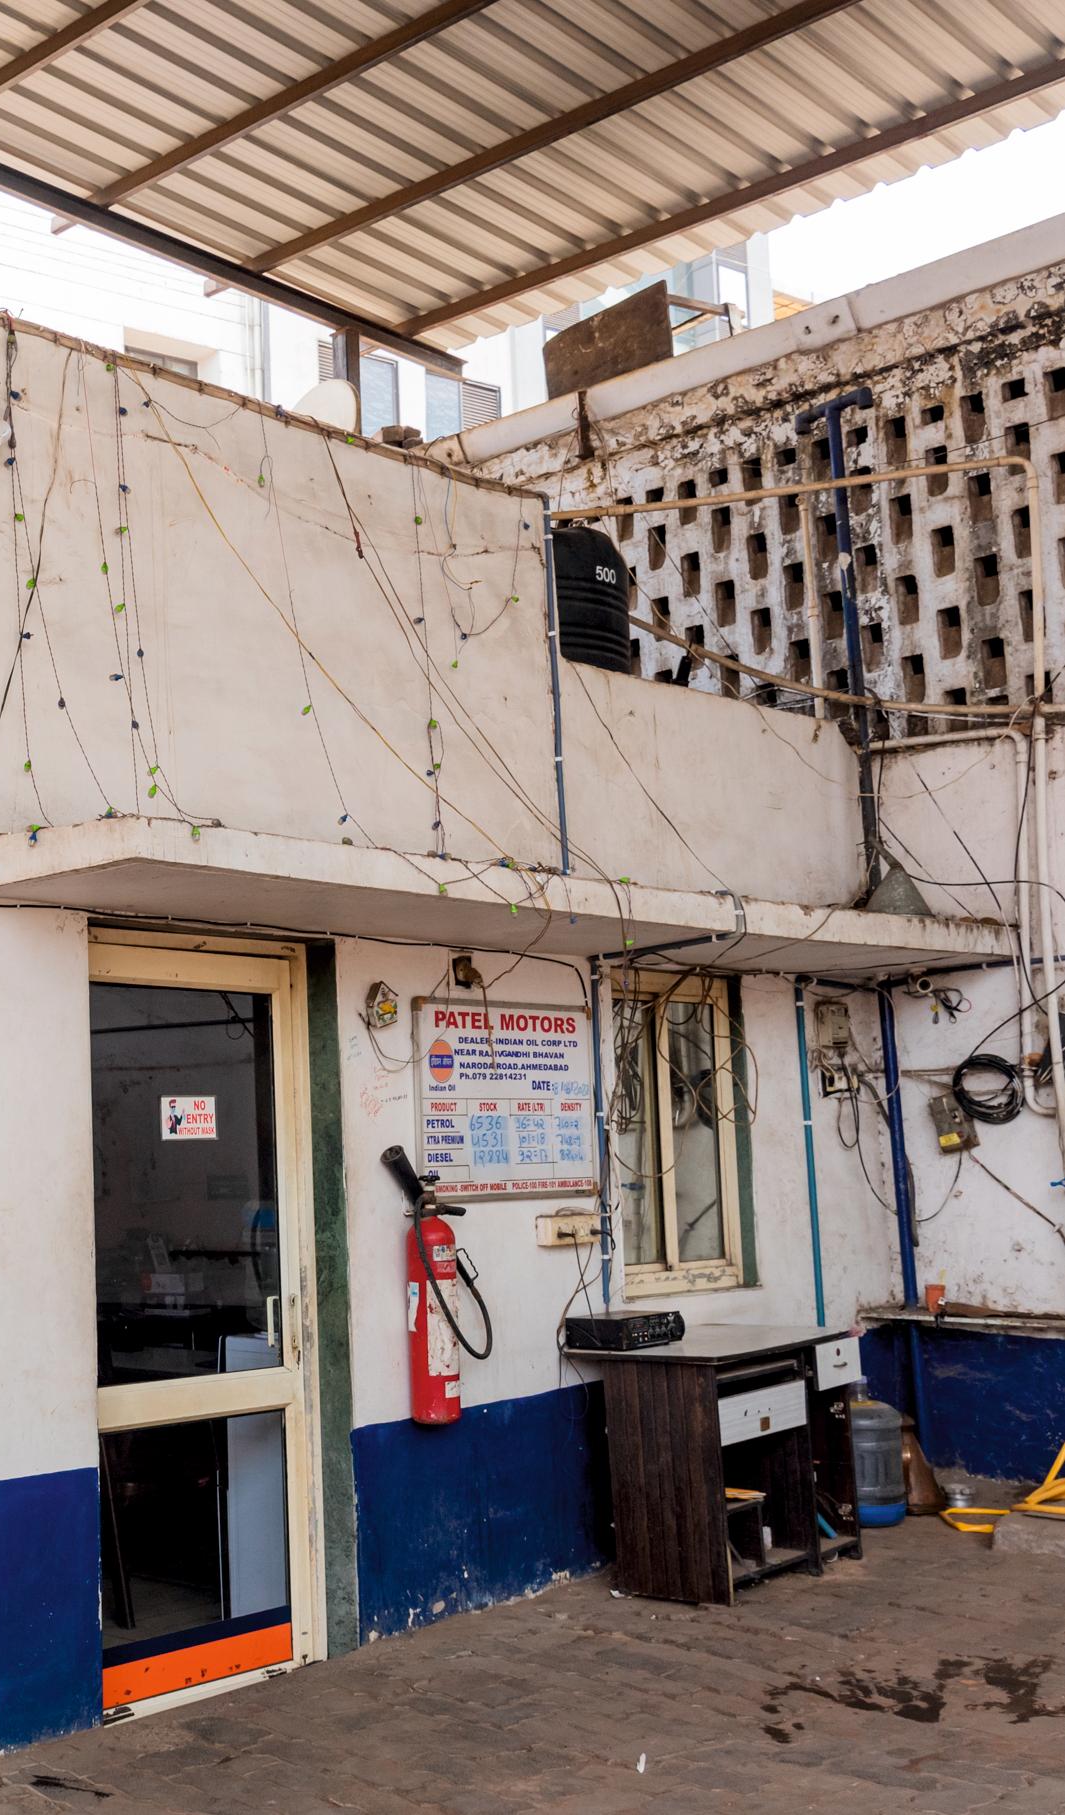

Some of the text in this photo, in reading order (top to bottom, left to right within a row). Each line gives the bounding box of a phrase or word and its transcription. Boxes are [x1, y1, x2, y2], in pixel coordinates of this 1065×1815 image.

[595, 565, 616, 584] 500
[434, 1010, 576, 1034] PATEL MOTORS
[526, 1039, 539, 1047] OIL
[541, 1039, 562, 1047] CORP
[454, 1049, 476, 1057] NEAR
[532, 1051, 565, 1059] BHAVAN
[459, 1062, 494, 1070] NARODA
[489, 1073, 527, 1081] 22814231
[429, 1084, 456, 1092] Indian Oil
[193, 1100, 206, 1110] NO
[430, 1102, 582, 1113] PRODUCT STOCK RATE (LTR) DENSITY
[186, 1114, 214, 1124] ENTRY
[426, 1118, 455, 1129] PETROL
[178, 1127, 215, 1135] WITHOUT MASK
[426, 1135, 464, 1145] XTRA PREMIUM
[427, 1152, 453, 1163] DIESEL
[480, 1183, 489, 1191] OFF
[489, 1182, 507, 1191] MOBILE
